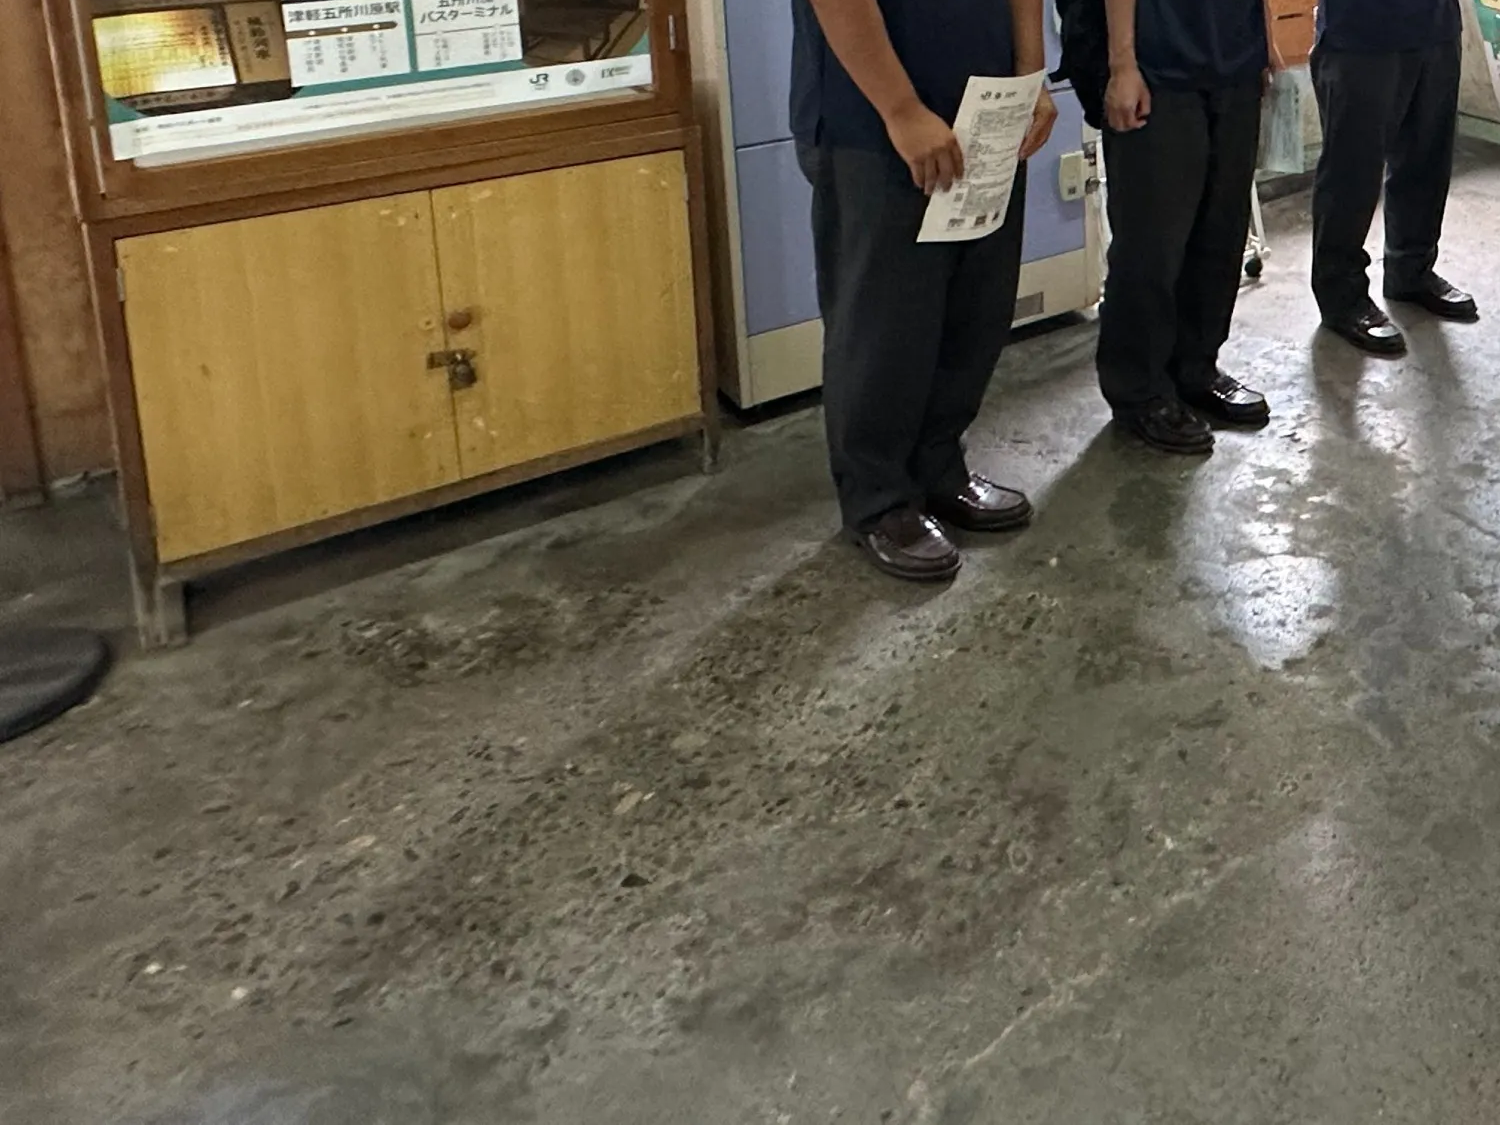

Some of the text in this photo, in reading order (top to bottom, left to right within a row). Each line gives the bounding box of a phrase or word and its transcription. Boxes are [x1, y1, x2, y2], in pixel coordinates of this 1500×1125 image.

[288, 1, 400, 23] 津軽五所川原駅
[421, 4, 513, 24] バスターミナル
